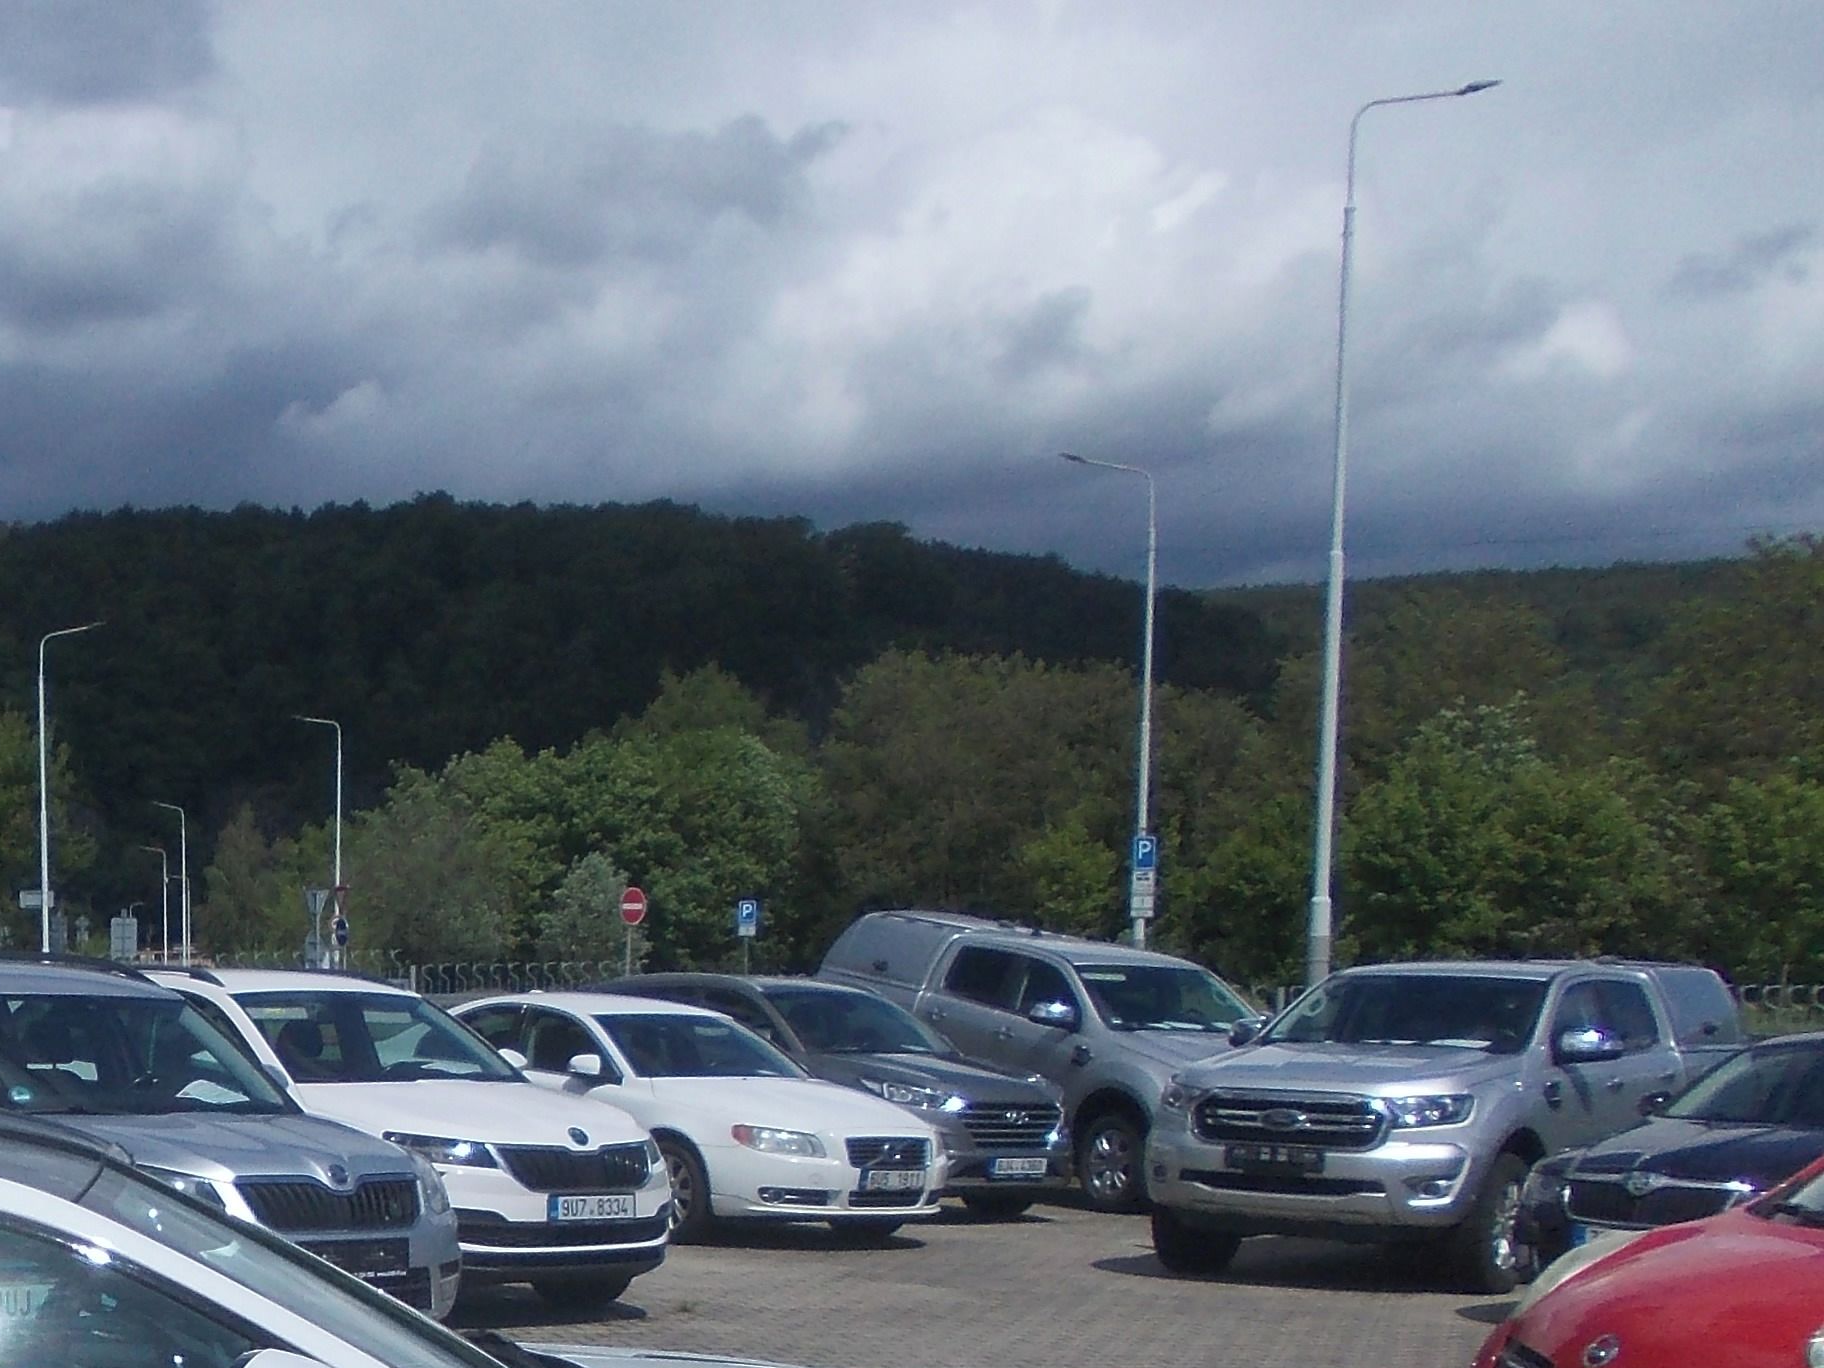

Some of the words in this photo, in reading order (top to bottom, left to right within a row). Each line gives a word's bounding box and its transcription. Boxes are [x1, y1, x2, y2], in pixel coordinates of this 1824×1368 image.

[1138, 840, 1152, 860] P
[742, 904, 753, 918] P
[562, 1199, 587, 1216] 9U7
[597, 1198, 628, 1216] 8334
